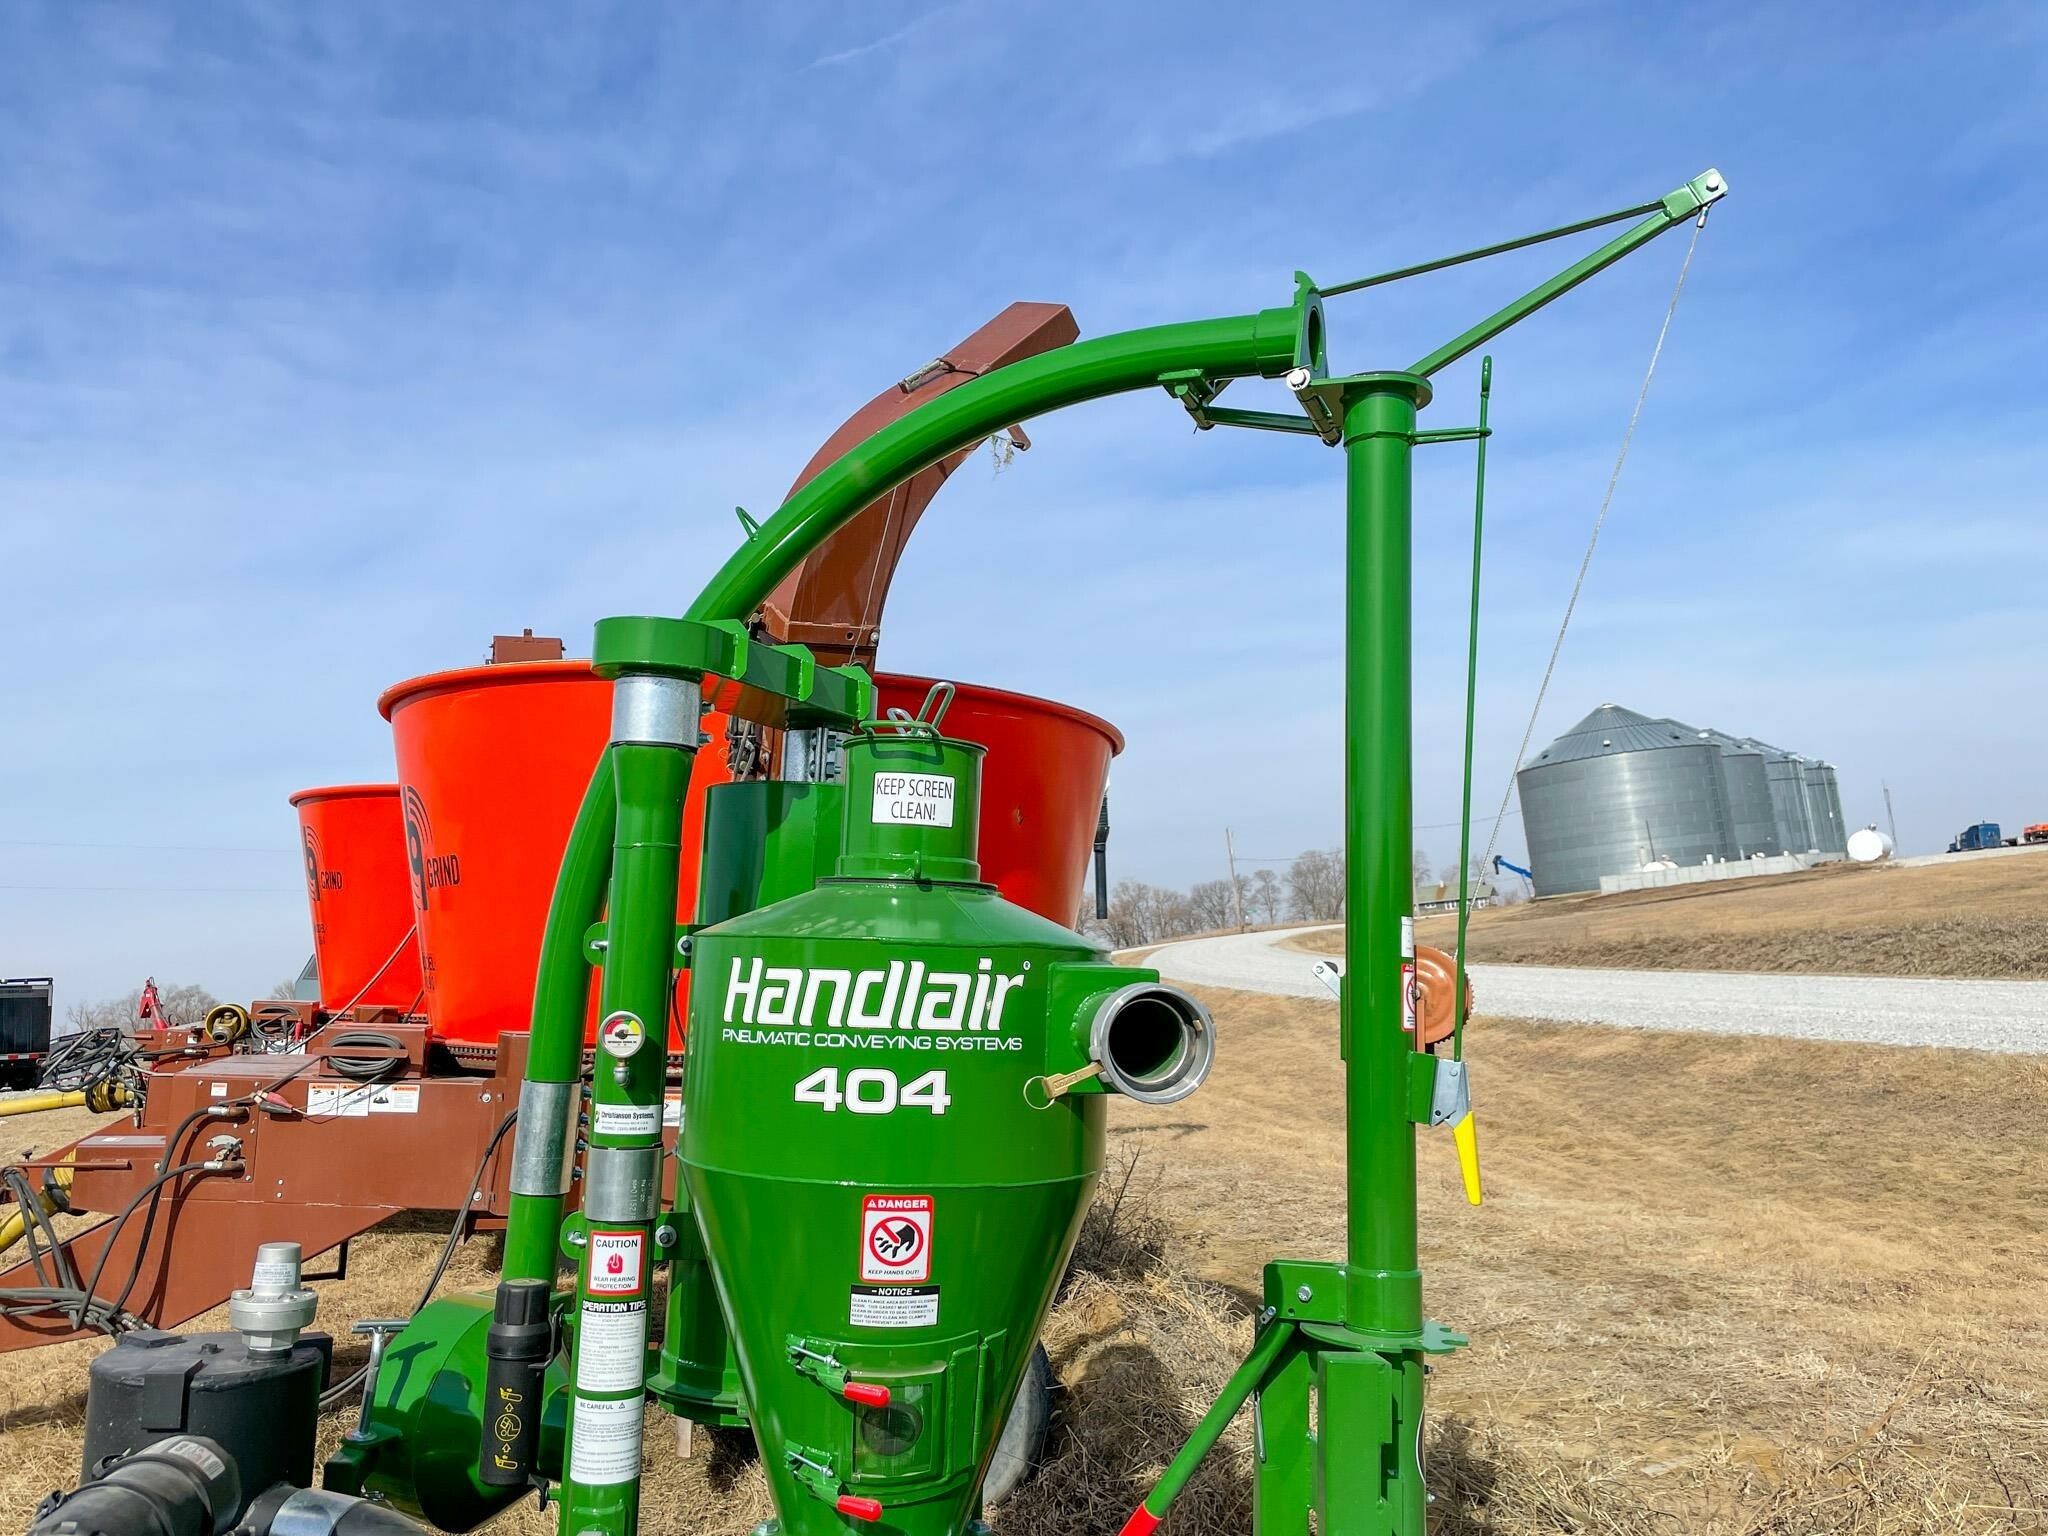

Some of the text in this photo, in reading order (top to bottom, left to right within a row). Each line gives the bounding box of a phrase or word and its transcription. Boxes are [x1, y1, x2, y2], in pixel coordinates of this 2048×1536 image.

[876, 778, 953, 799] KEEP SCREEN
[891, 801, 936, 821] CLEAN!
[320, 872, 343, 889] GRIND
[426, 855, 460, 888] GRIND
[723, 957, 1025, 1031] Handlair
[722, 1028, 1023, 1051] PNEUMATIC CONVEYING SYSTEMS
[793, 1066, 952, 1115] 404
[878, 1199, 928, 1209] DANGER
[596, 1239, 638, 1248] CAUTION
[878, 1287, 913, 1296] NOTICE
[582, 1300, 646, 1312] OPERATION TIPS
